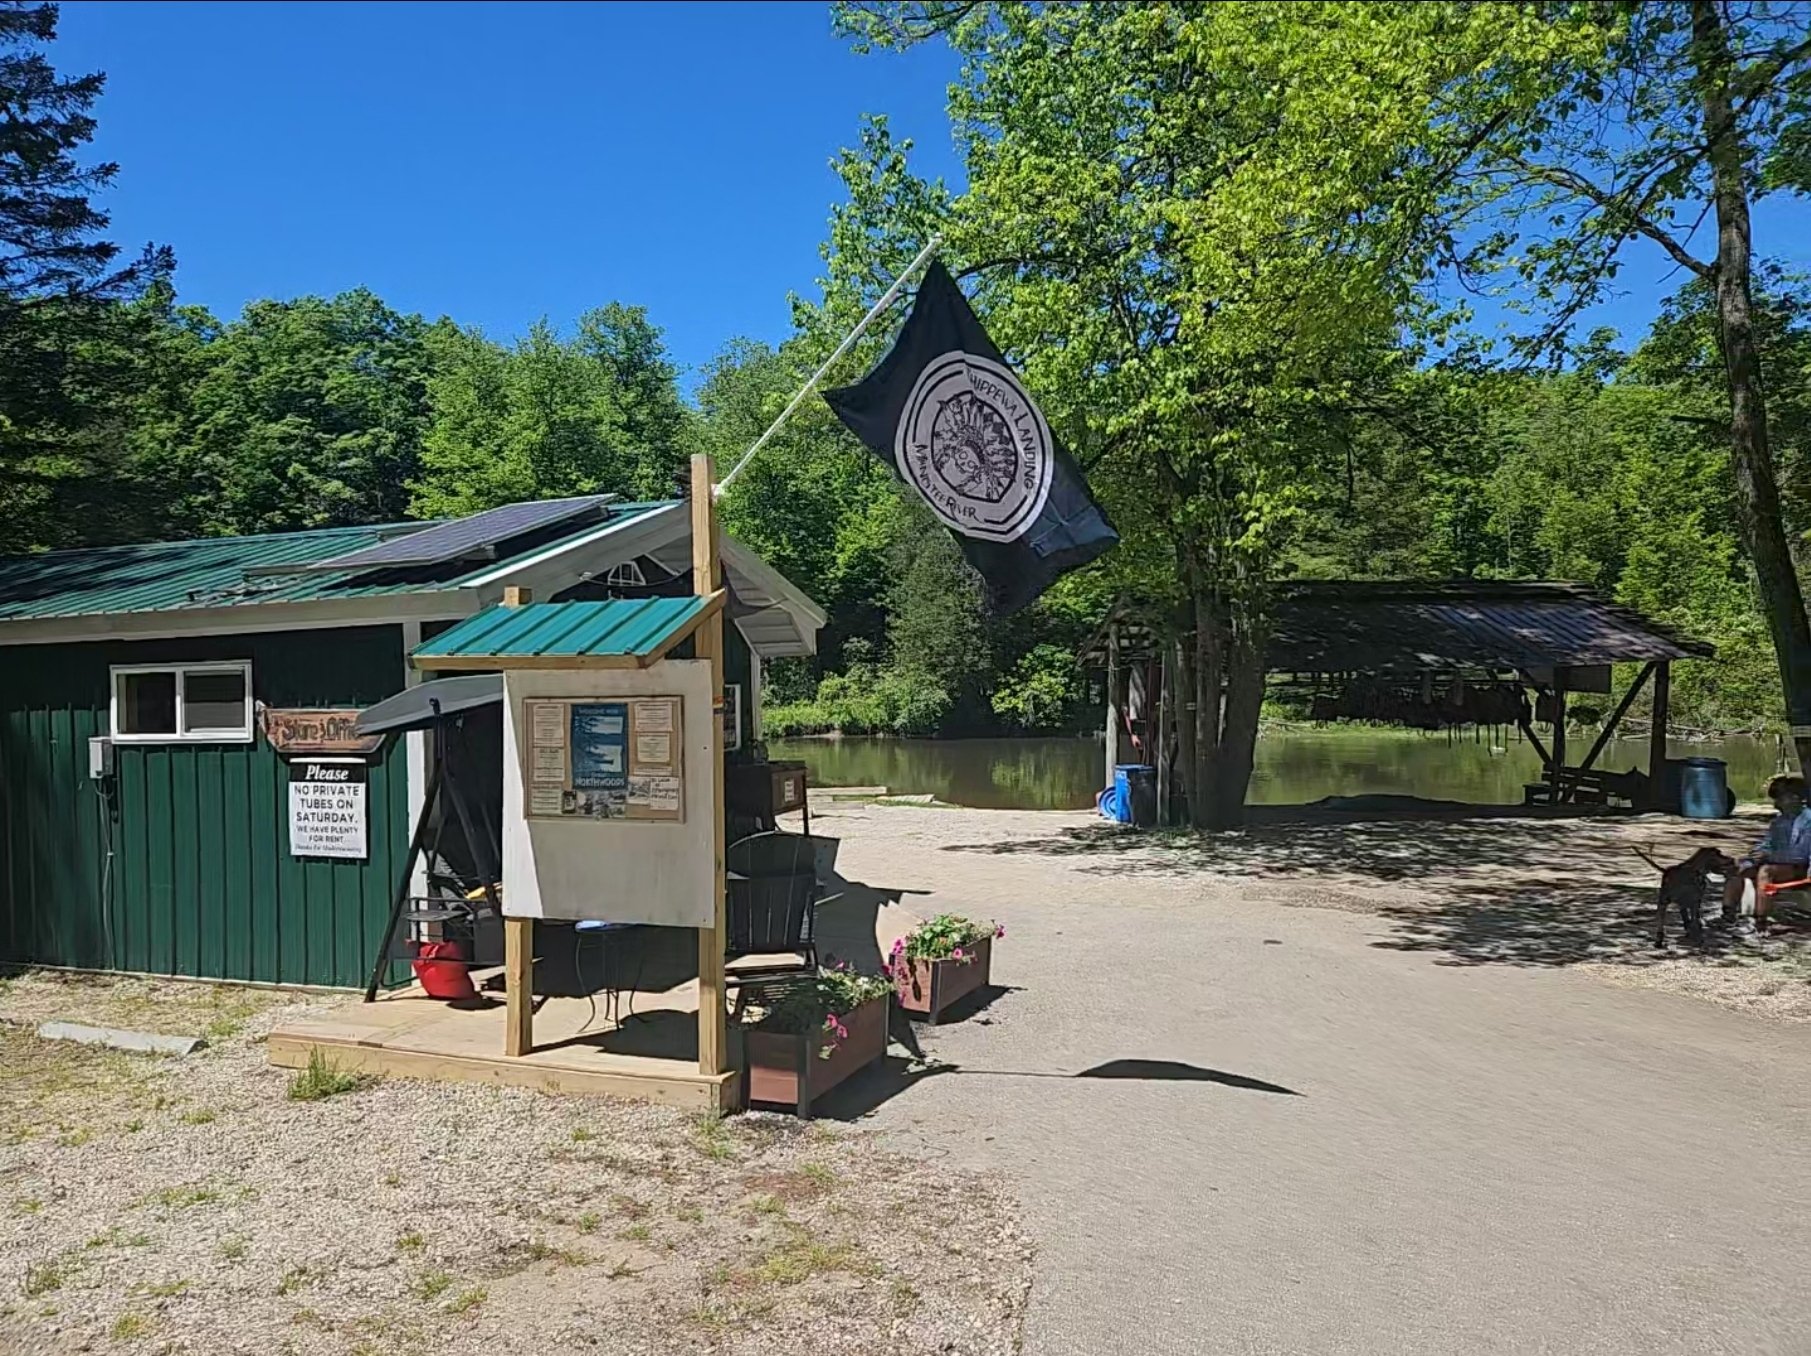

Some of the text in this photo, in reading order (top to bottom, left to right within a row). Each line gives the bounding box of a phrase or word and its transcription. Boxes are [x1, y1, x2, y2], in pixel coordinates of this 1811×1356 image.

[967, 367, 1036, 490] HIPPEWA LANDING
[282, 718, 318, 741] Store
[326, 716, 360, 741] Offic
[305, 764, 349, 781] Please
[294, 785, 360, 797] NO PRIVATE
[300, 799, 354, 809] TUBES ON
[296, 811, 358, 823] SATURDAY.
[296, 825, 359, 834] WE HAVE PLENTY
[325, 835, 344, 843] RENT
